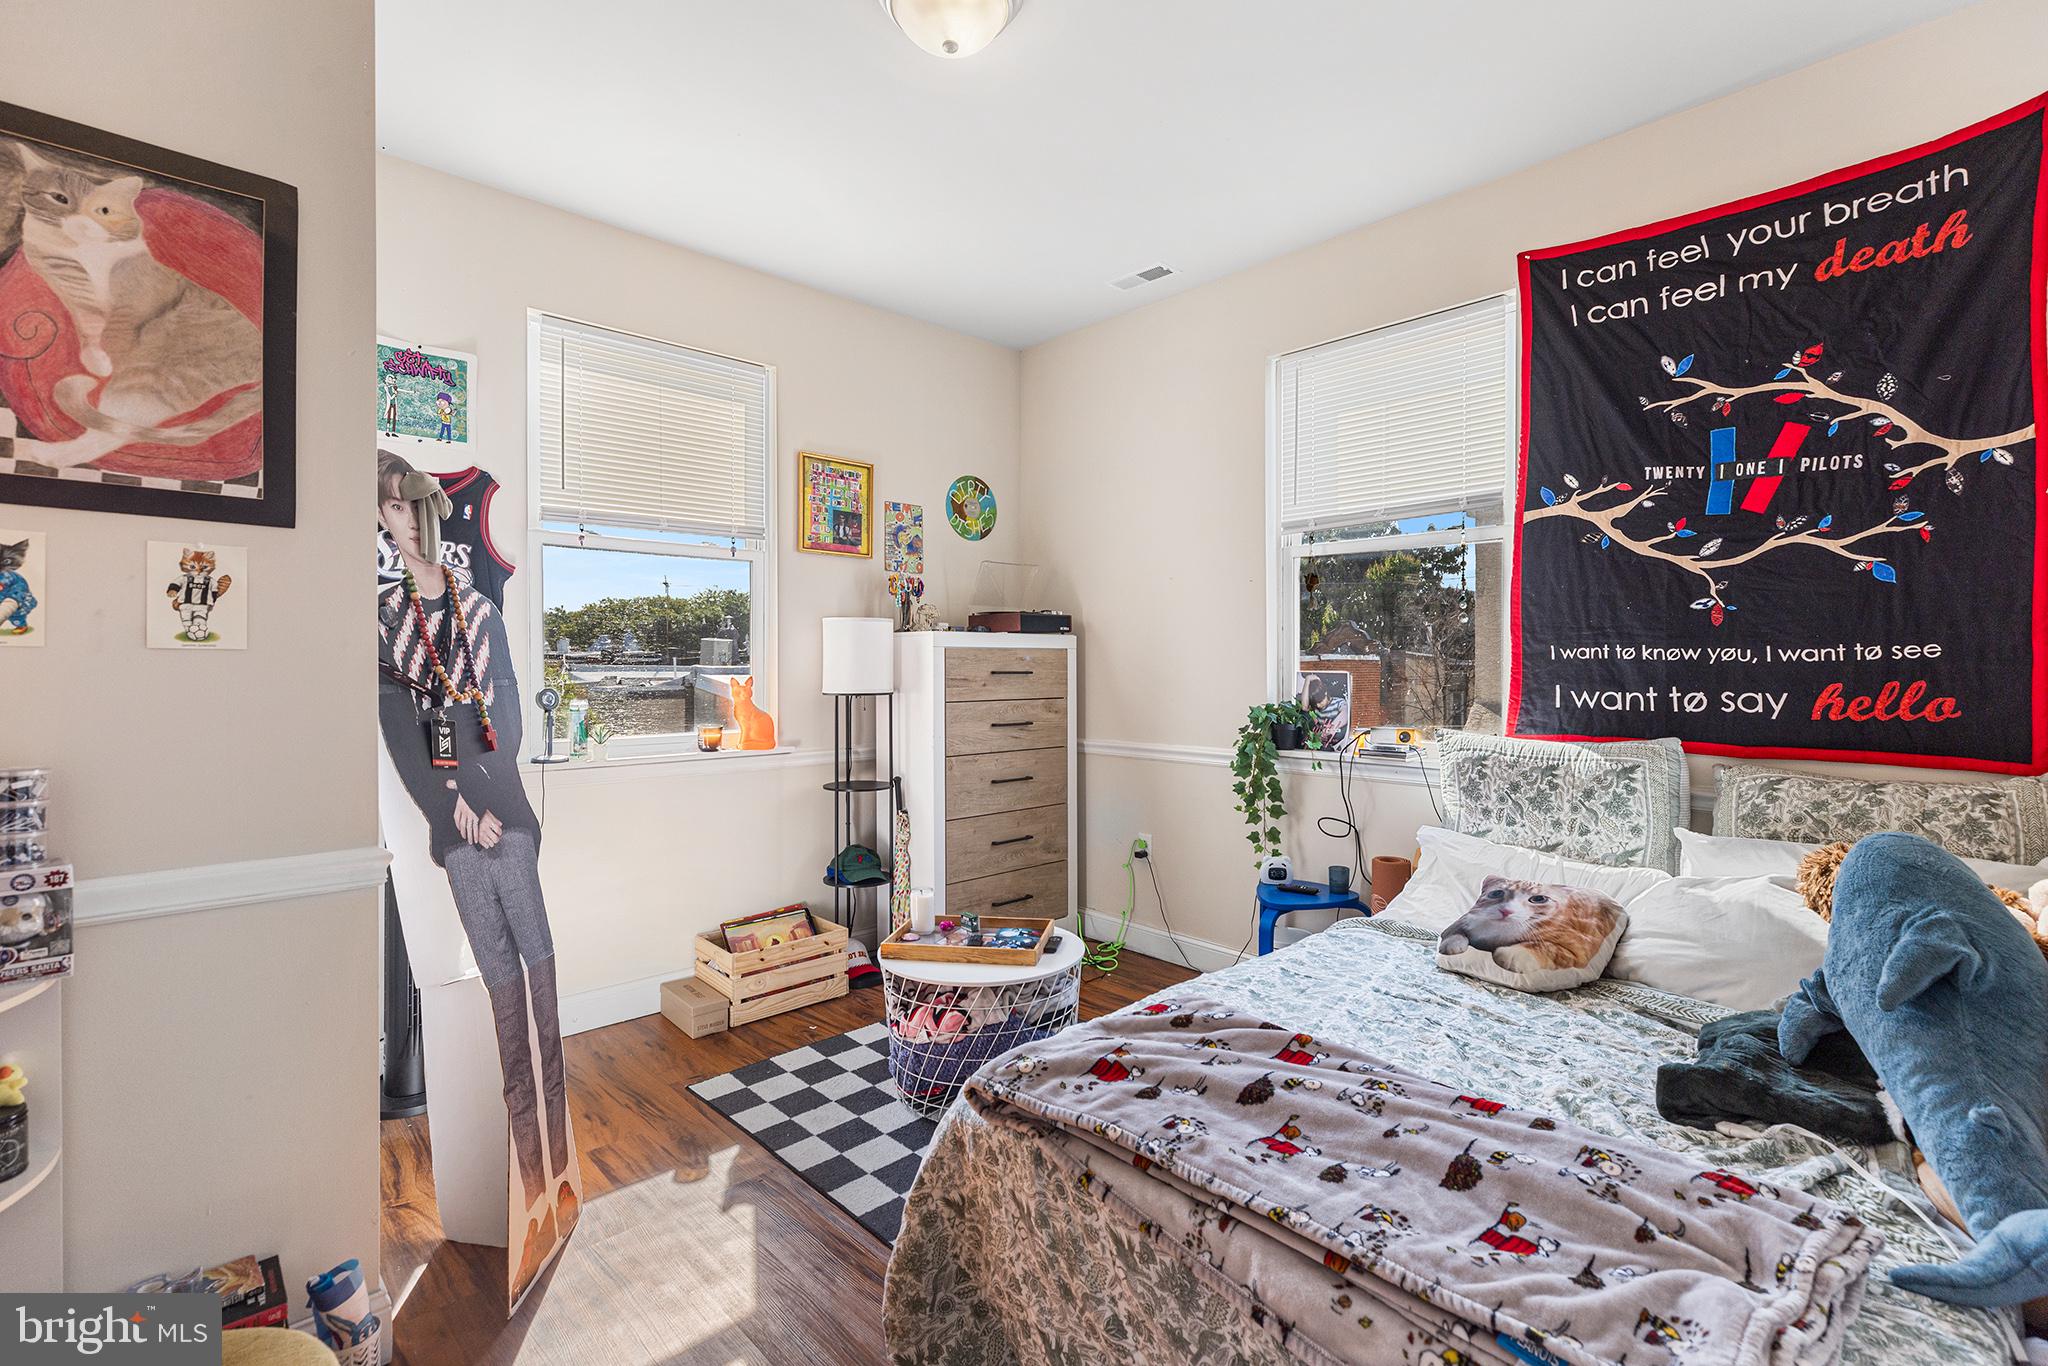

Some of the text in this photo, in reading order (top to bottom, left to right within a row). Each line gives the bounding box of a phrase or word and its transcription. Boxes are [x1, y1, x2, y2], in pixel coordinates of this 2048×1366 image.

[1576, 260, 1637, 288] can
[1646, 234, 1710, 272] feel
[1726, 211, 1812, 257] your
[1823, 163, 1969, 228] breath
[1586, 297, 1649, 324] can
[1659, 273, 1726, 311] feel
[1738, 262, 1798, 293] my
[1814, 209, 1973, 282] death
[394, 347, 428, 366] GET
[382, 358, 456, 387] SCHWIFTY
[1644, 465, 1706, 481] TWENTY
[1735, 460, 1767, 477] ONE
[1799, 453, 1864, 472] PILOTS
[949, 479, 991, 505] DIRTY
[950, 506, 994, 538] DISHES
[1559, 643, 1610, 660] want
[1777, 643, 1847, 663] want
[1891, 643, 1942, 660] see
[1569, 686, 1658, 712] want
[1720, 691, 1789, 720] say
[1810, 680, 1962, 723] hello
[438, 726, 451, 735] VIP
[31, 961, 61, 972] SANTA
